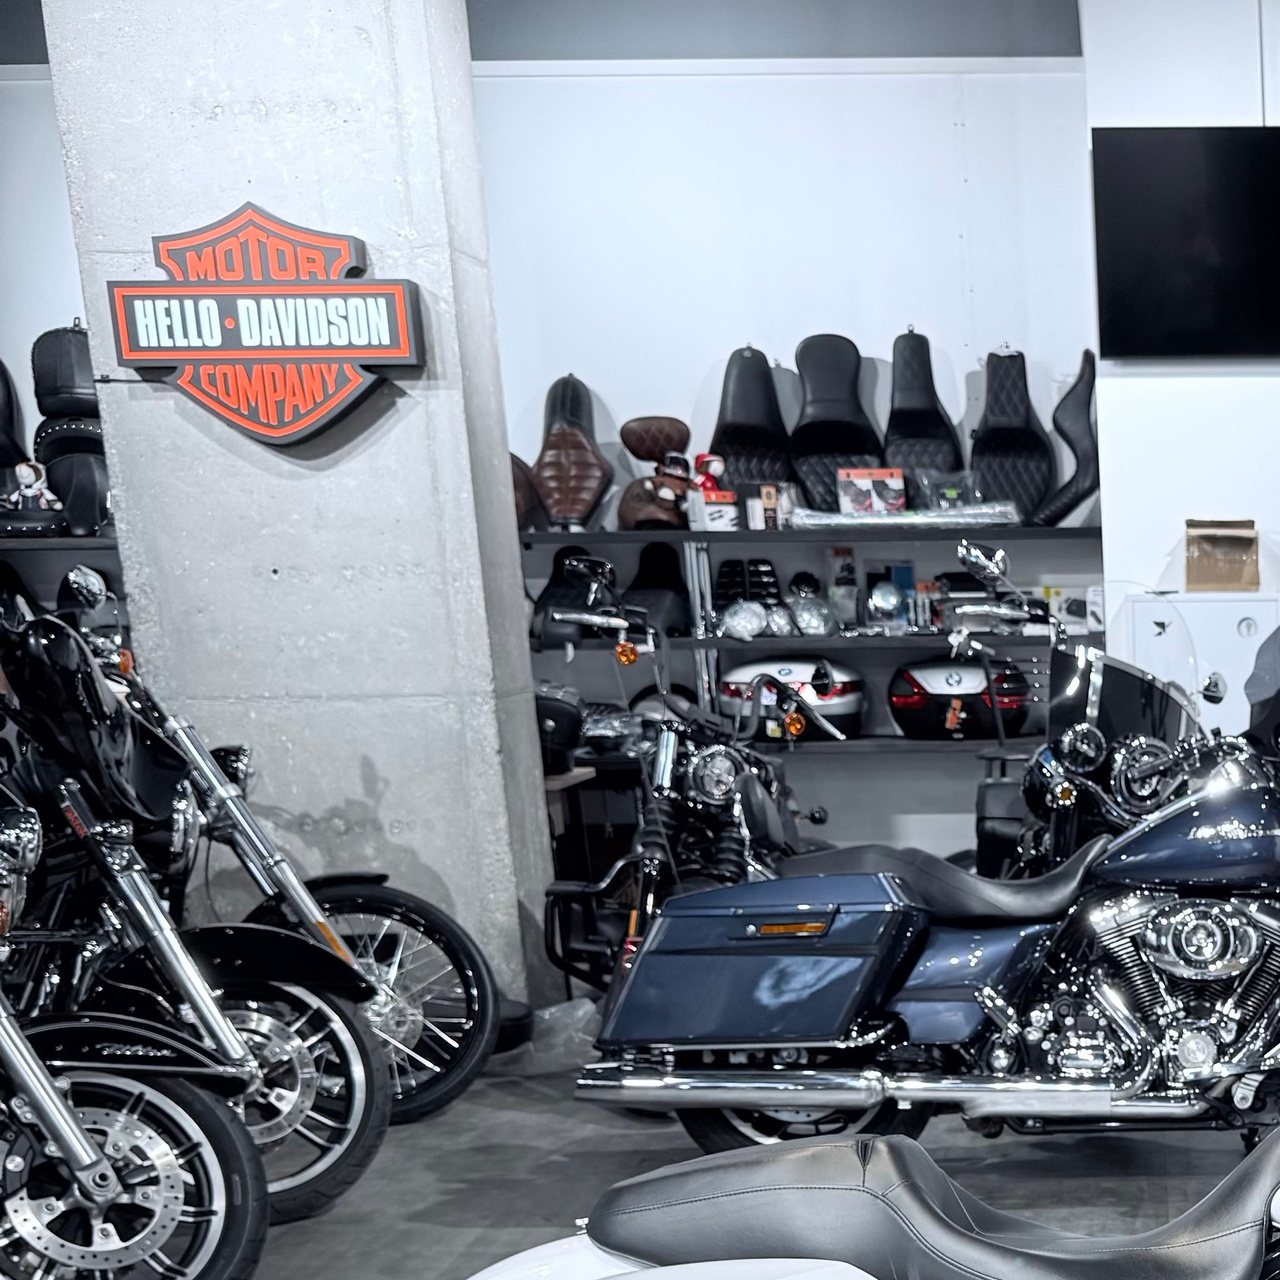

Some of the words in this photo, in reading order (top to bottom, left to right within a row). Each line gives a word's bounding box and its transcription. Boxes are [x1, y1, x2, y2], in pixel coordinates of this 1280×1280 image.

[186, 225, 327, 281] MOTOR
[133, 298, 222, 347] HELLO
[236, 297, 391, 346] DAVIDSON
[200, 363, 339, 425] COMPANY
